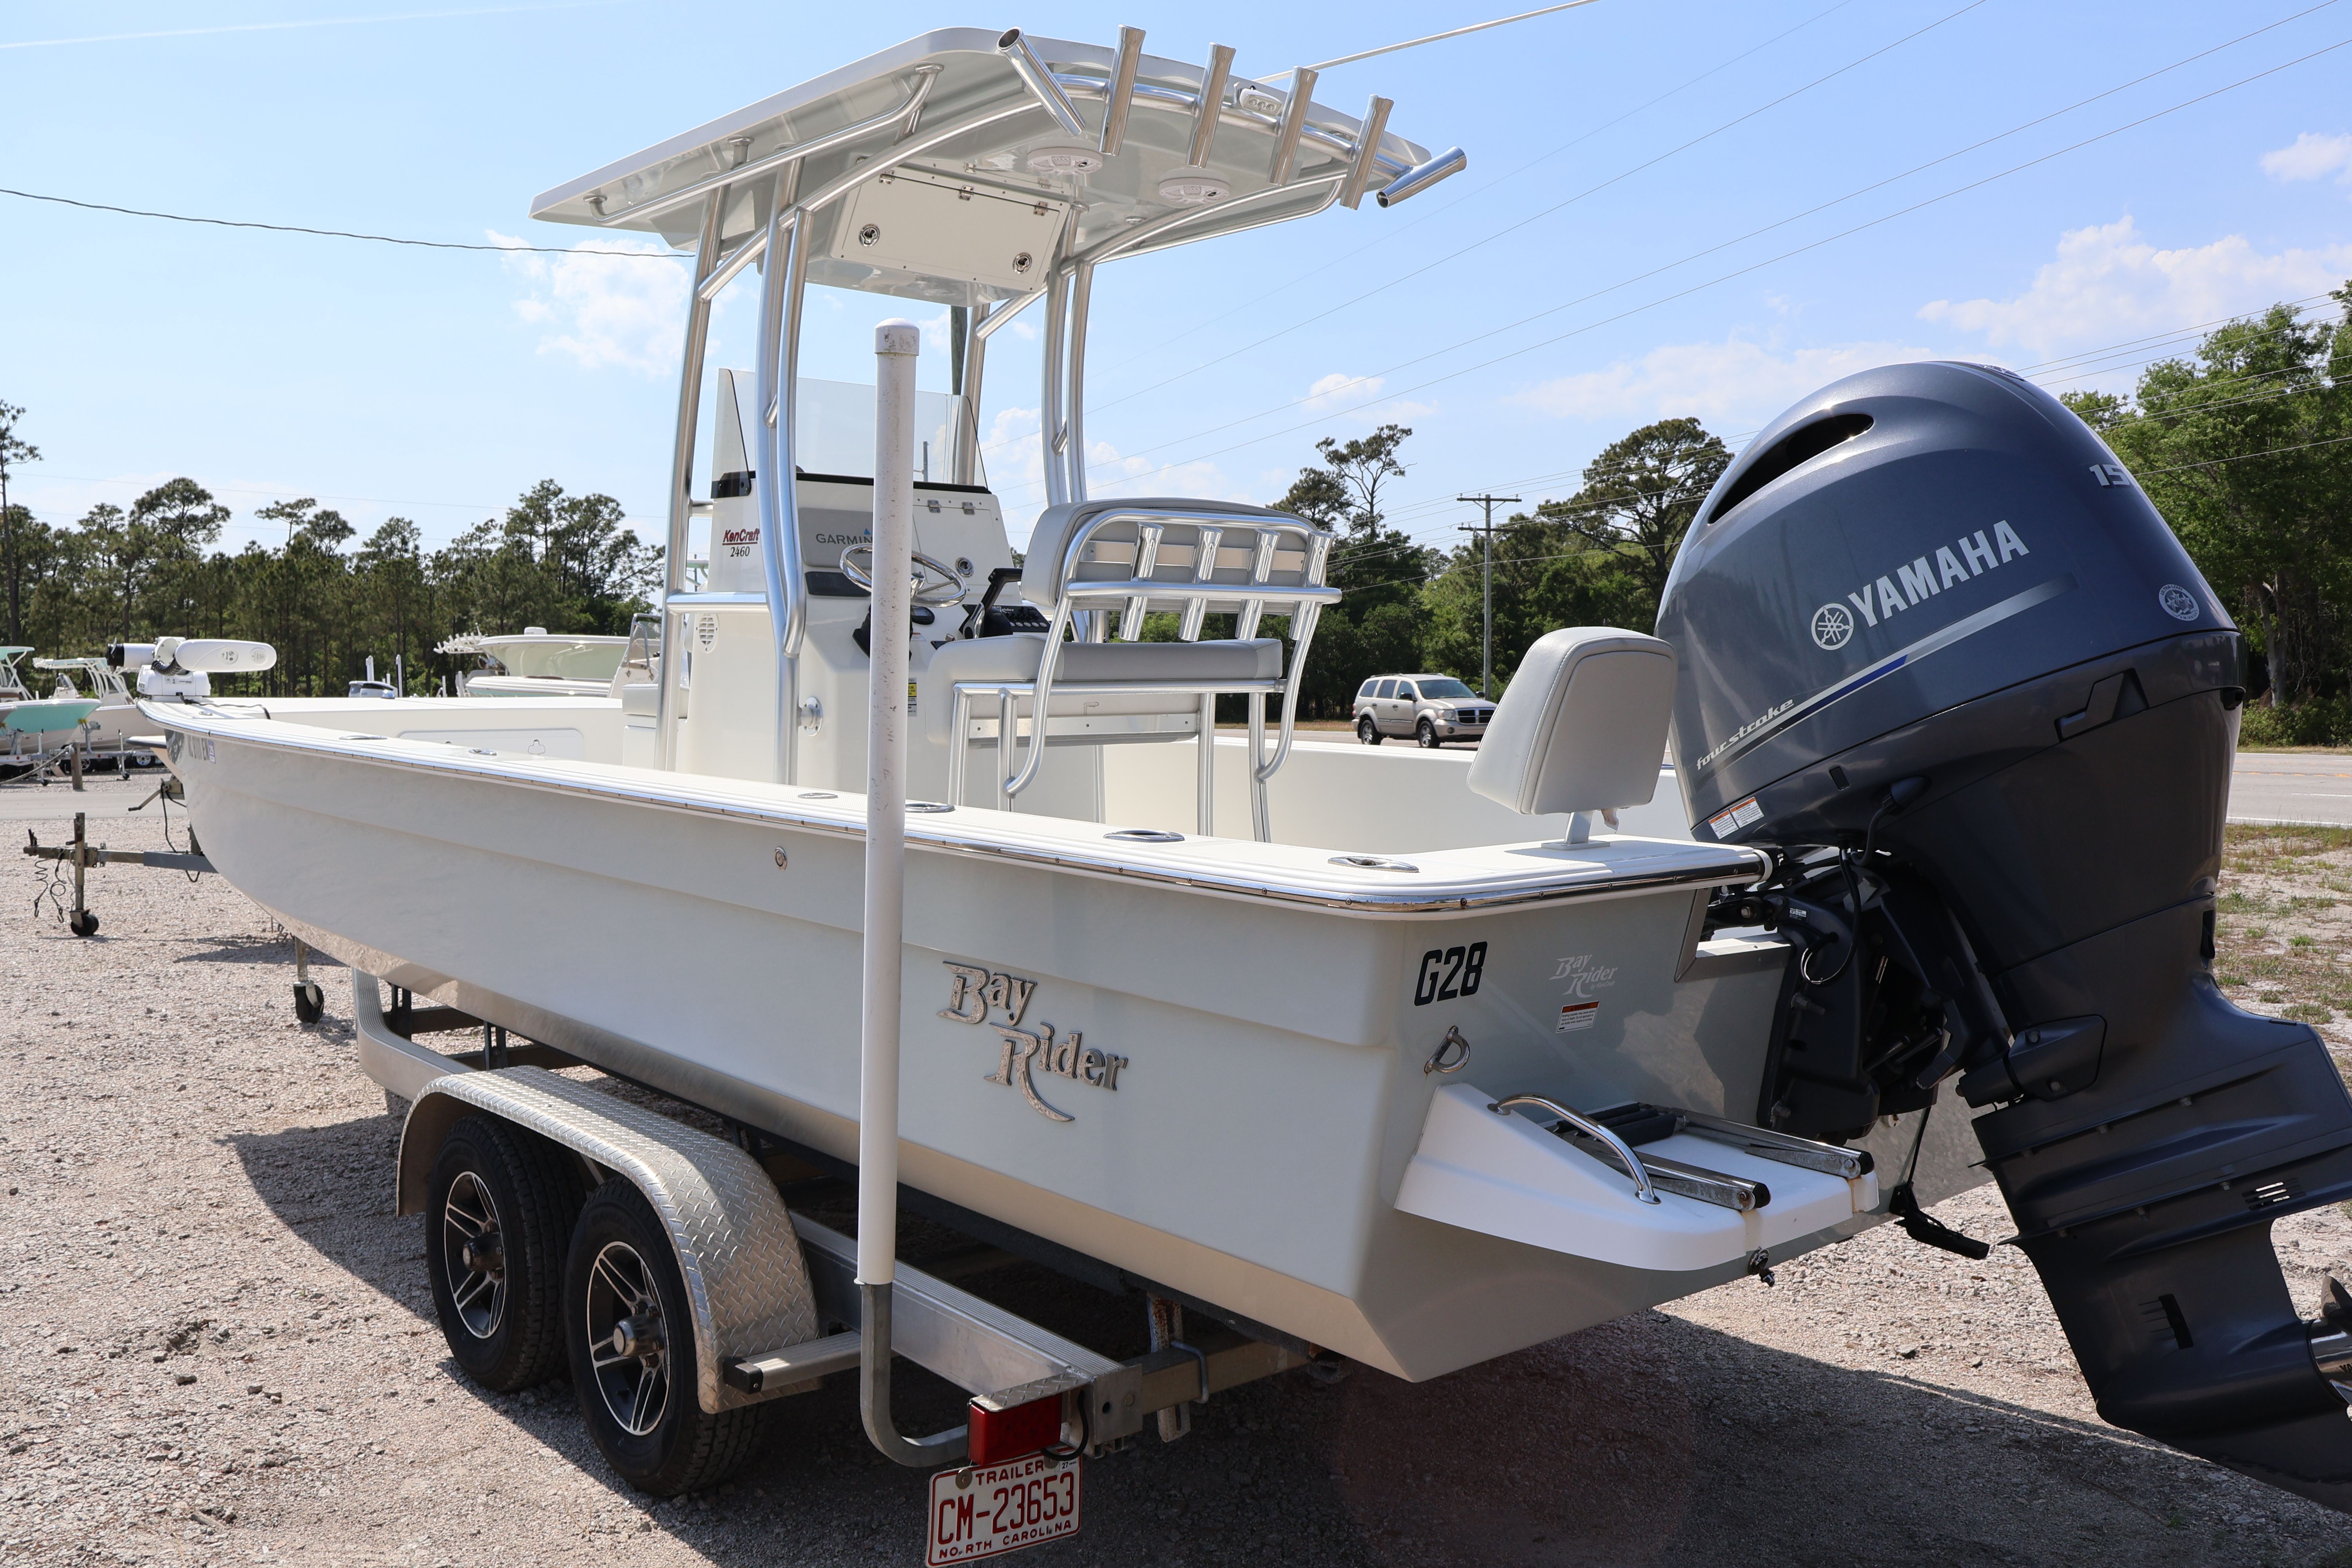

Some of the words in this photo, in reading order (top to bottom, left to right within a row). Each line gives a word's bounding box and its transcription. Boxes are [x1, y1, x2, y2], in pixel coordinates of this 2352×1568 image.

[723, 528, 760, 542] KenCraft
[730, 546, 750, 557] 2460
[816, 534, 873, 544] GARMIN
[1847, 520, 2030, 627] YAMAHA
[1414, 941, 1488, 1006] G28
[1549, 955, 1593, 980] Bay
[1562, 966, 1618, 998] Rider
[936, 961, 1037, 1026] Bay
[984, 1022, 1129, 1122] Rider
[975, 1460, 1044, 1485] TRAILER
[938, 1471, 1074, 1545] CM-23653
[939, 1540, 992, 1559] NORTH
[1003, 1520, 1071, 1545] CAROLINA
